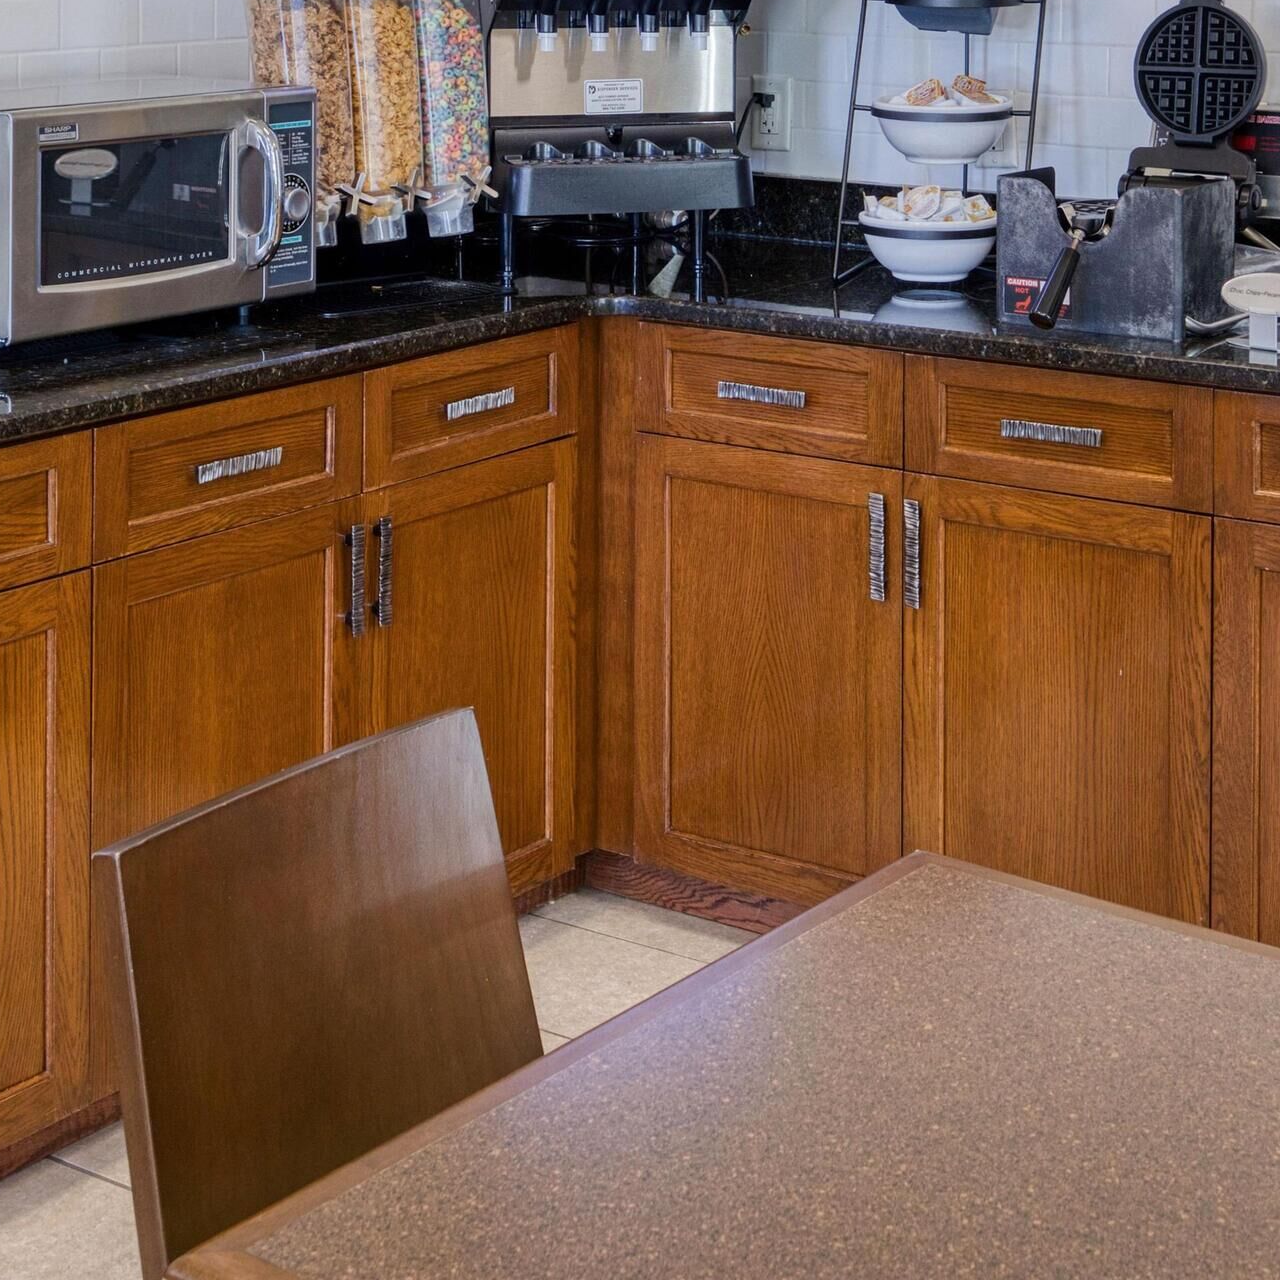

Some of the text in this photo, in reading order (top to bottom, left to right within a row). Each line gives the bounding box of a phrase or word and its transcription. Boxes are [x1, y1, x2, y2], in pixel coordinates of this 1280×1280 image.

[44, 125, 72, 134] SHARP
[57, 251, 213, 279] COMMERCIAL MICROWAVE OVEN
[1006, 277, 1039, 288] CAUTION
